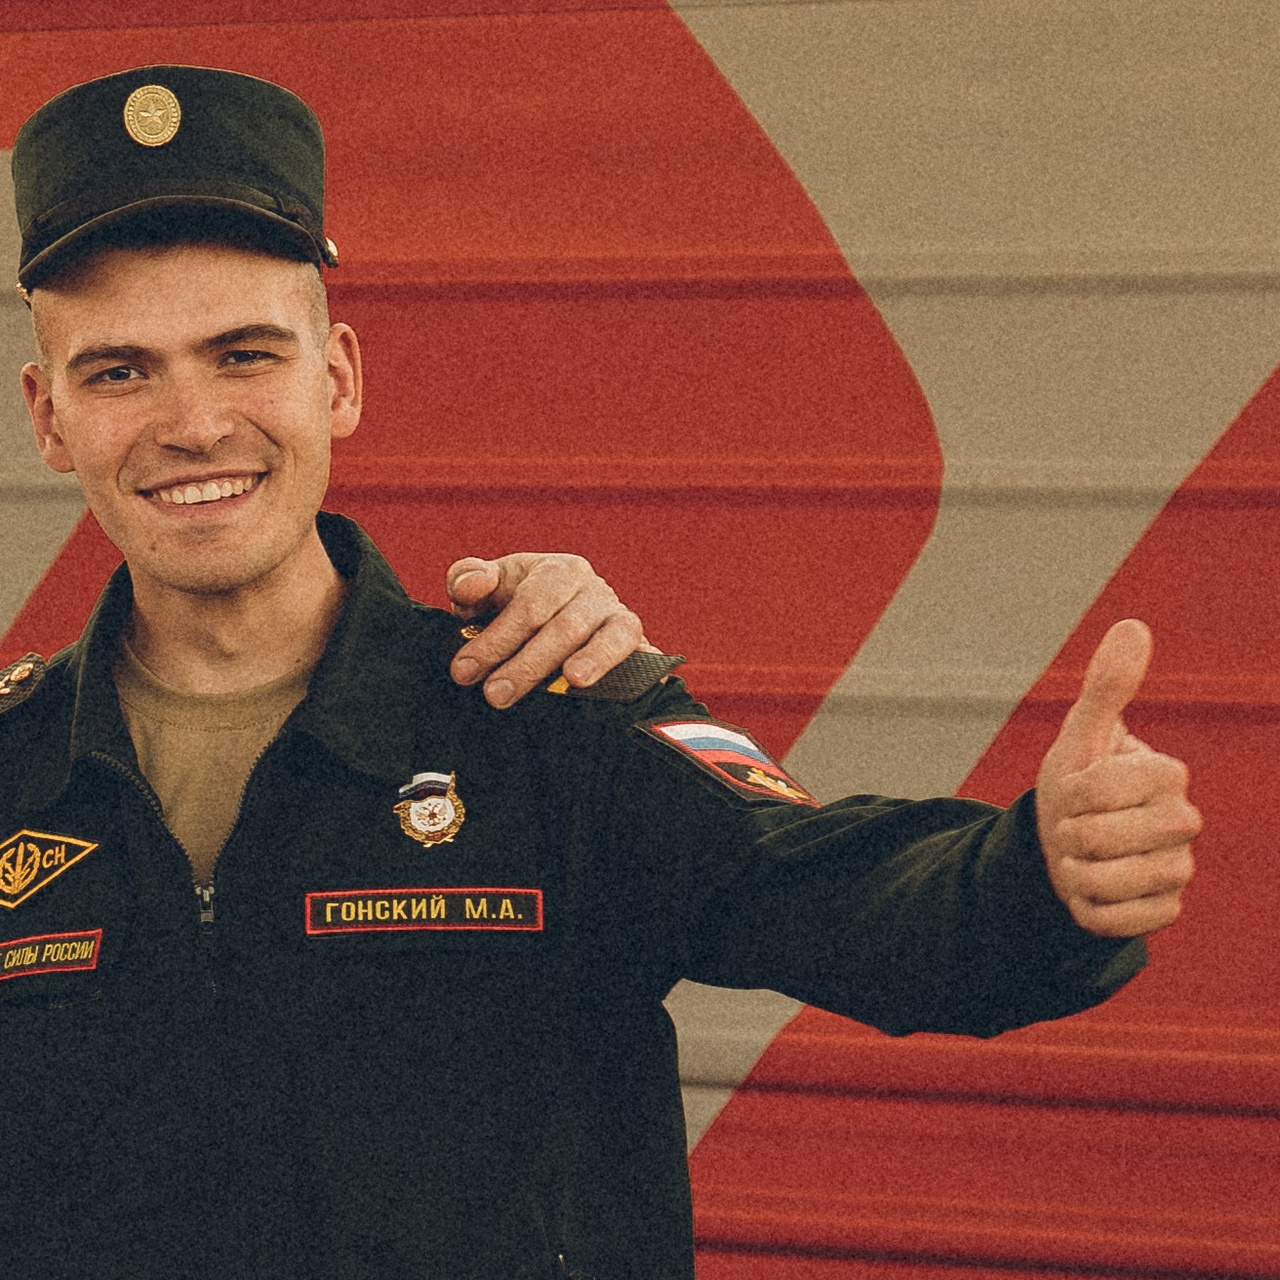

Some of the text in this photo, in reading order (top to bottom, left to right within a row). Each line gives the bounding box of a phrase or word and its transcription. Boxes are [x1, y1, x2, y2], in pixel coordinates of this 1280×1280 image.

[325, 894, 523, 922] ГОНСКИЙ М.А.
[4, 945, 39, 969] СИЛЫ
[42, 940, 95, 962] РОССИИ
